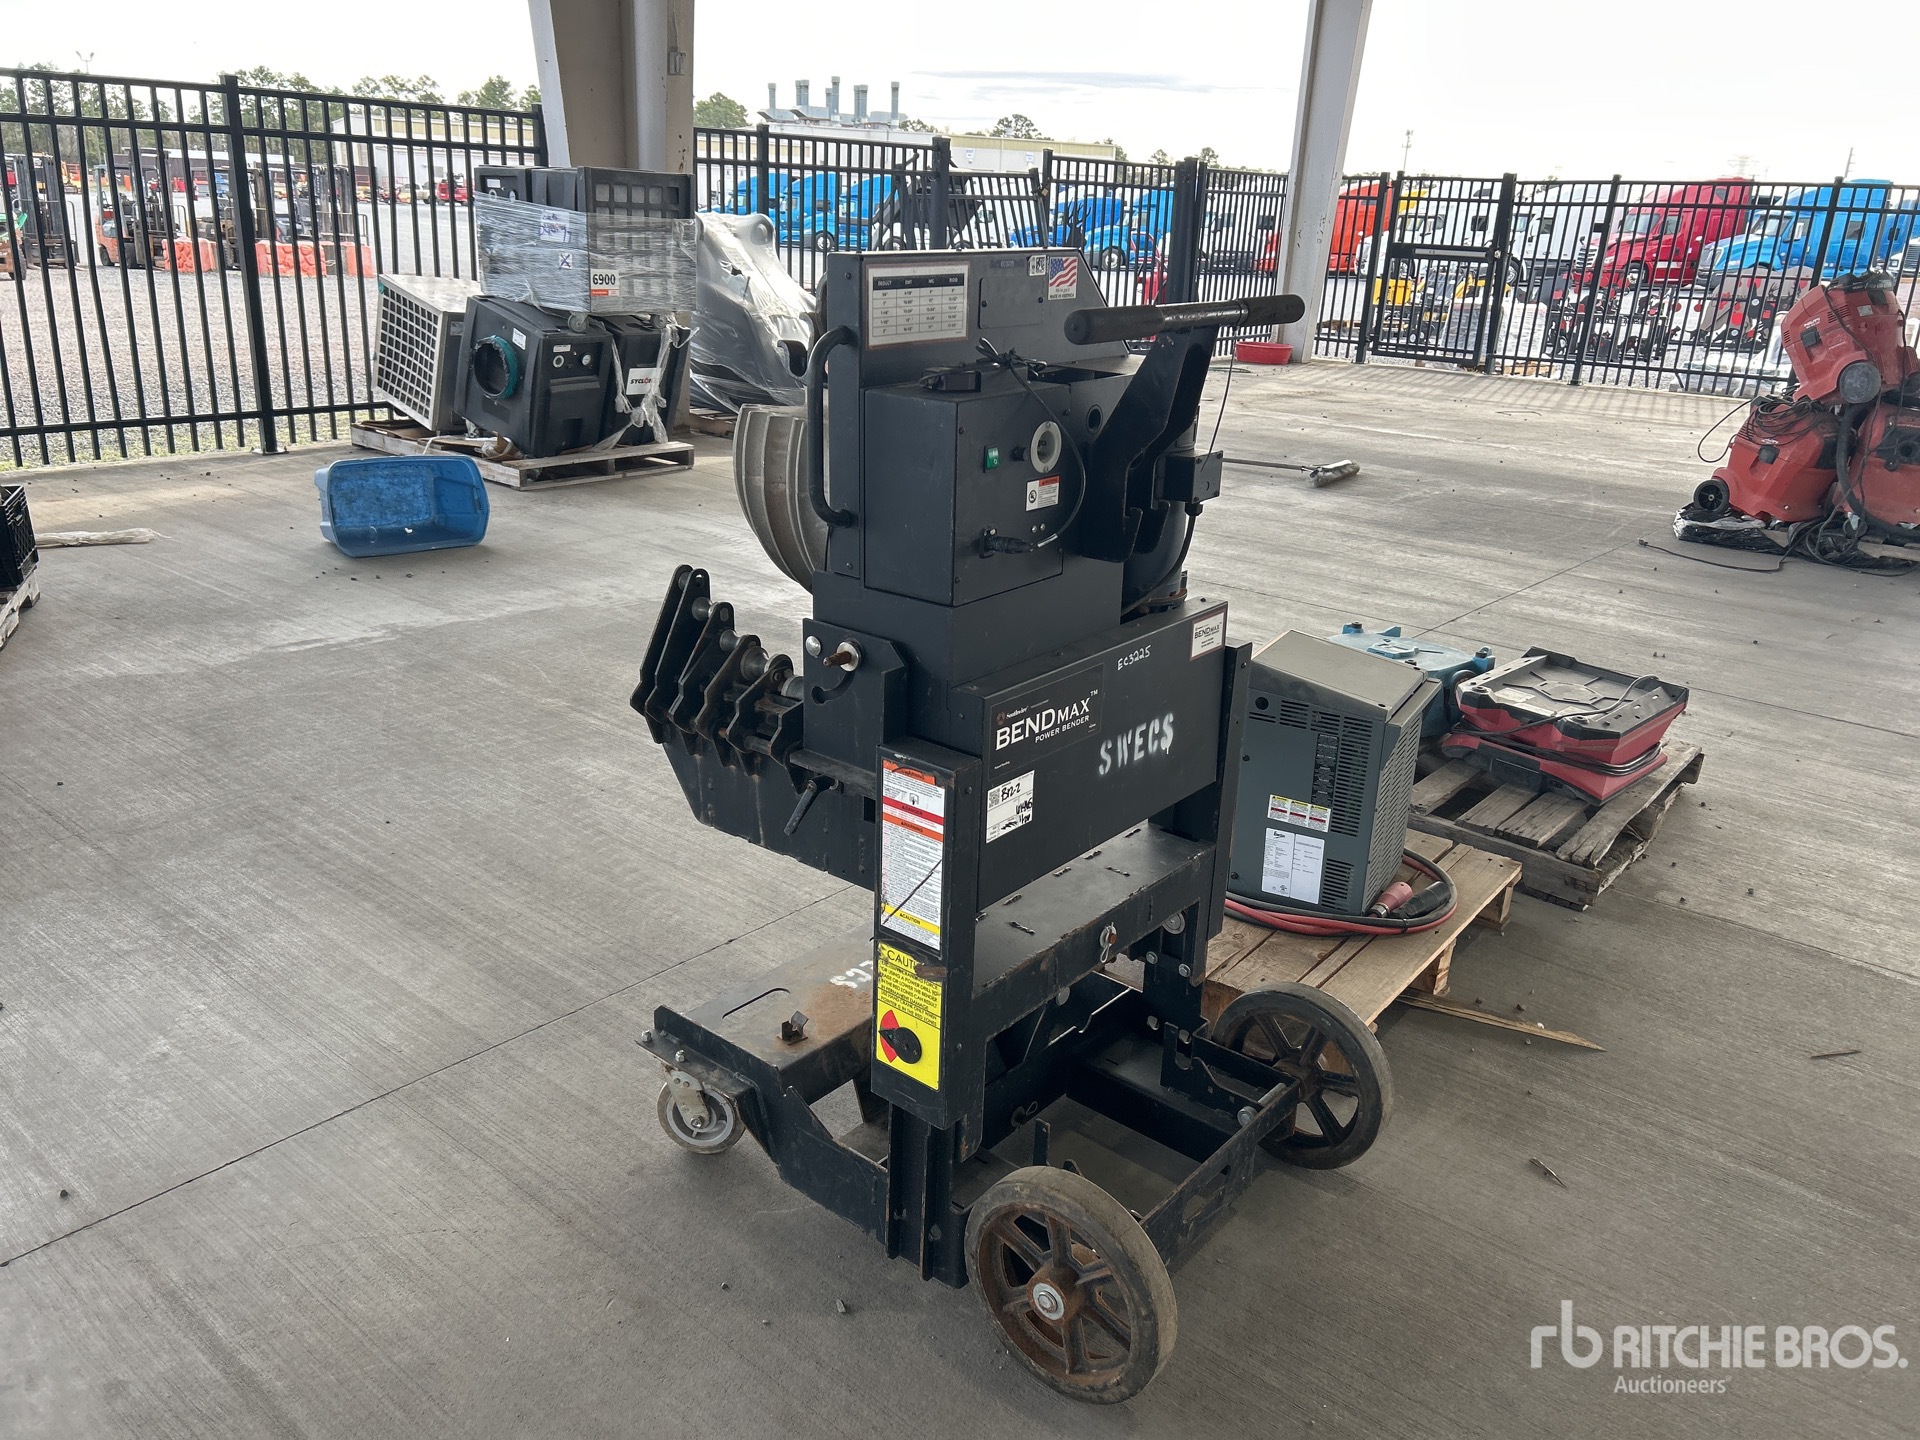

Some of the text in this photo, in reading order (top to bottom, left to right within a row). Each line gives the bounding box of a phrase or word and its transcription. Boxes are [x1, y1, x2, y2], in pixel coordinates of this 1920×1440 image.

[592, 273, 616, 285] 6900
[996, 697, 1090, 751] BENDMAX
[1035, 727, 1060, 743] POWER
[1061, 714, 1090, 732] BENDER
[1098, 711, 1175, 775] SWECS
